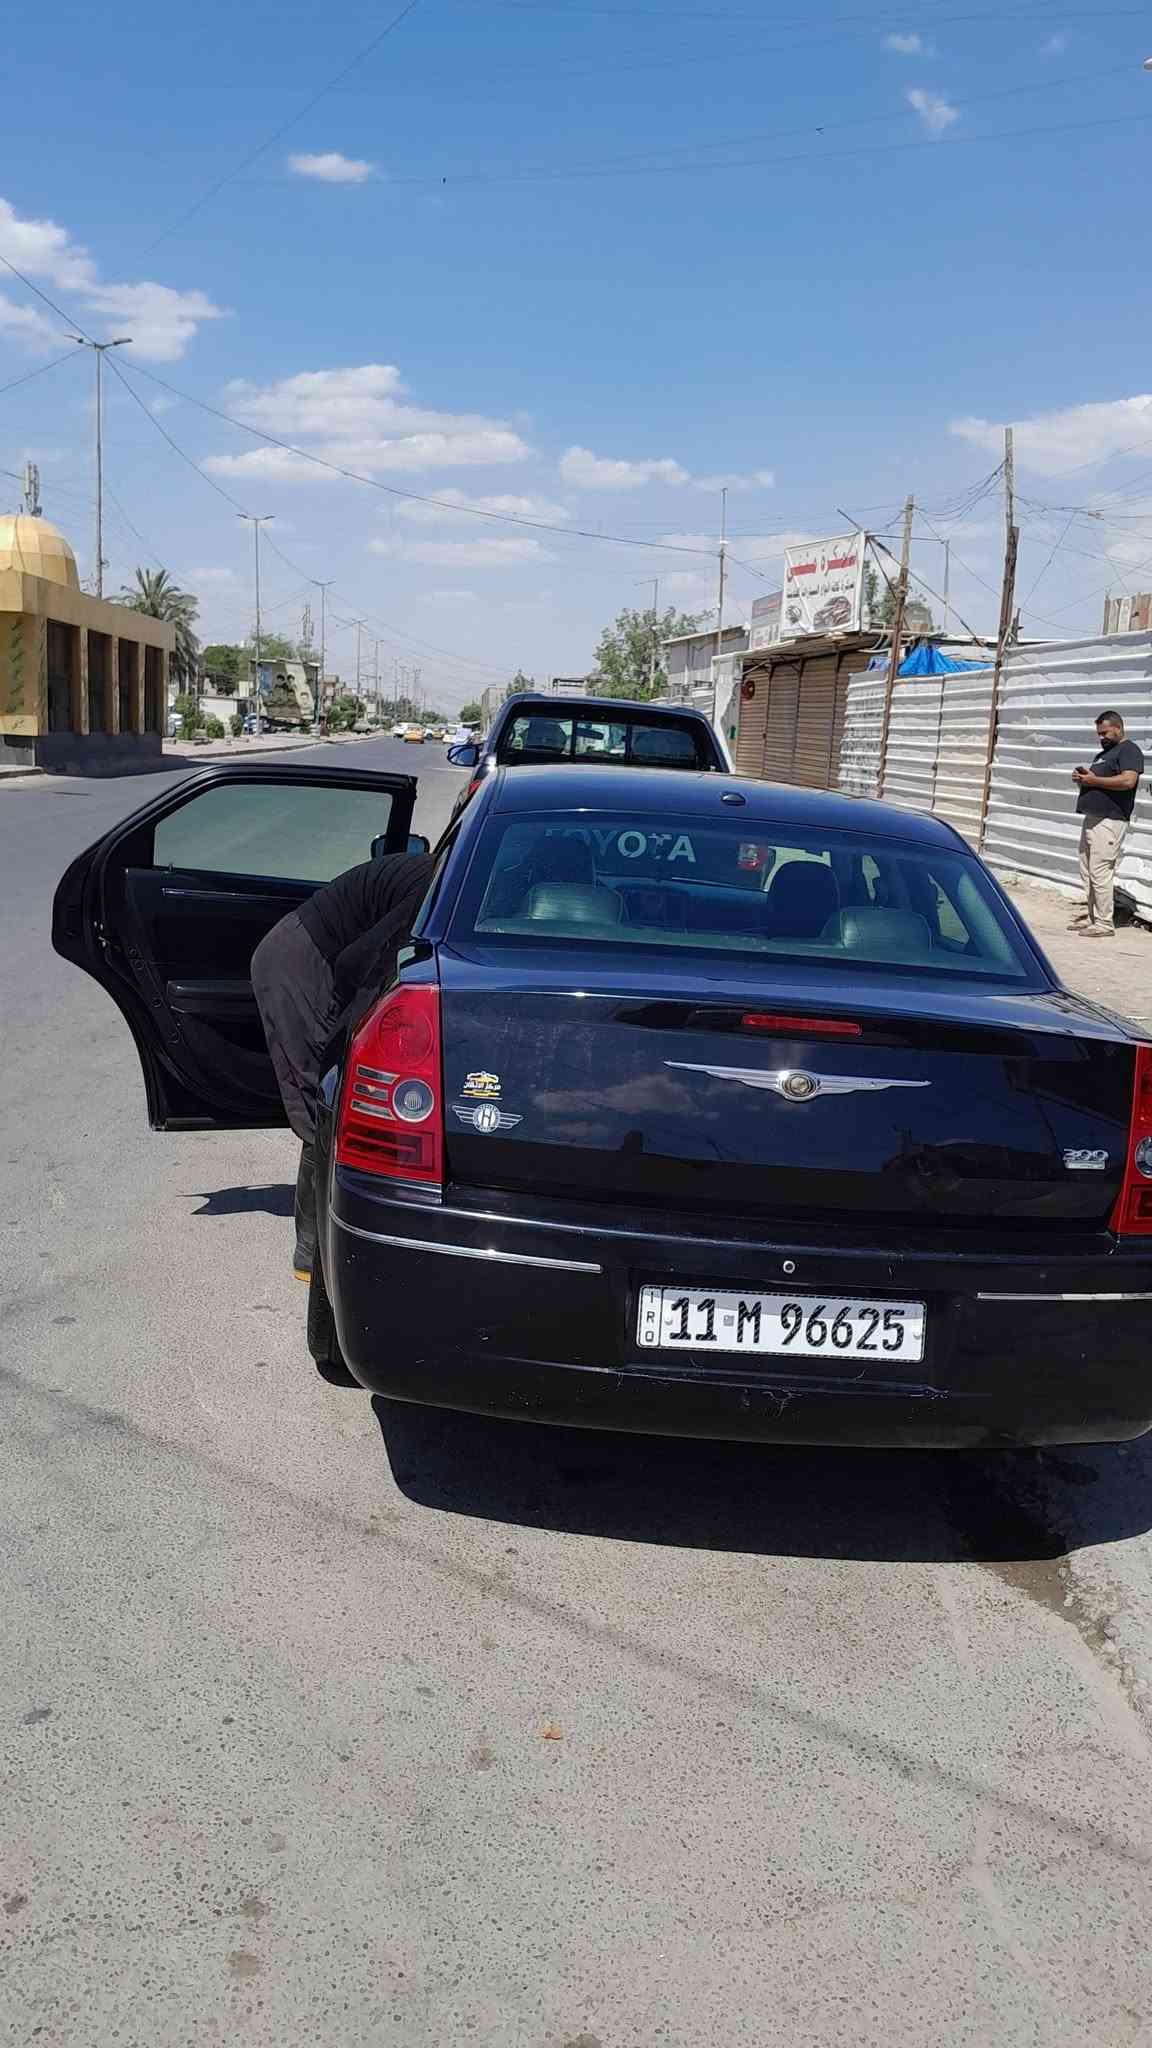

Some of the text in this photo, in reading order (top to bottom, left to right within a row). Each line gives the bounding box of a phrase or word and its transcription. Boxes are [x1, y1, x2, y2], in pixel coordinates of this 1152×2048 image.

[669, 1296, 906, 1351] 11 M 96625
